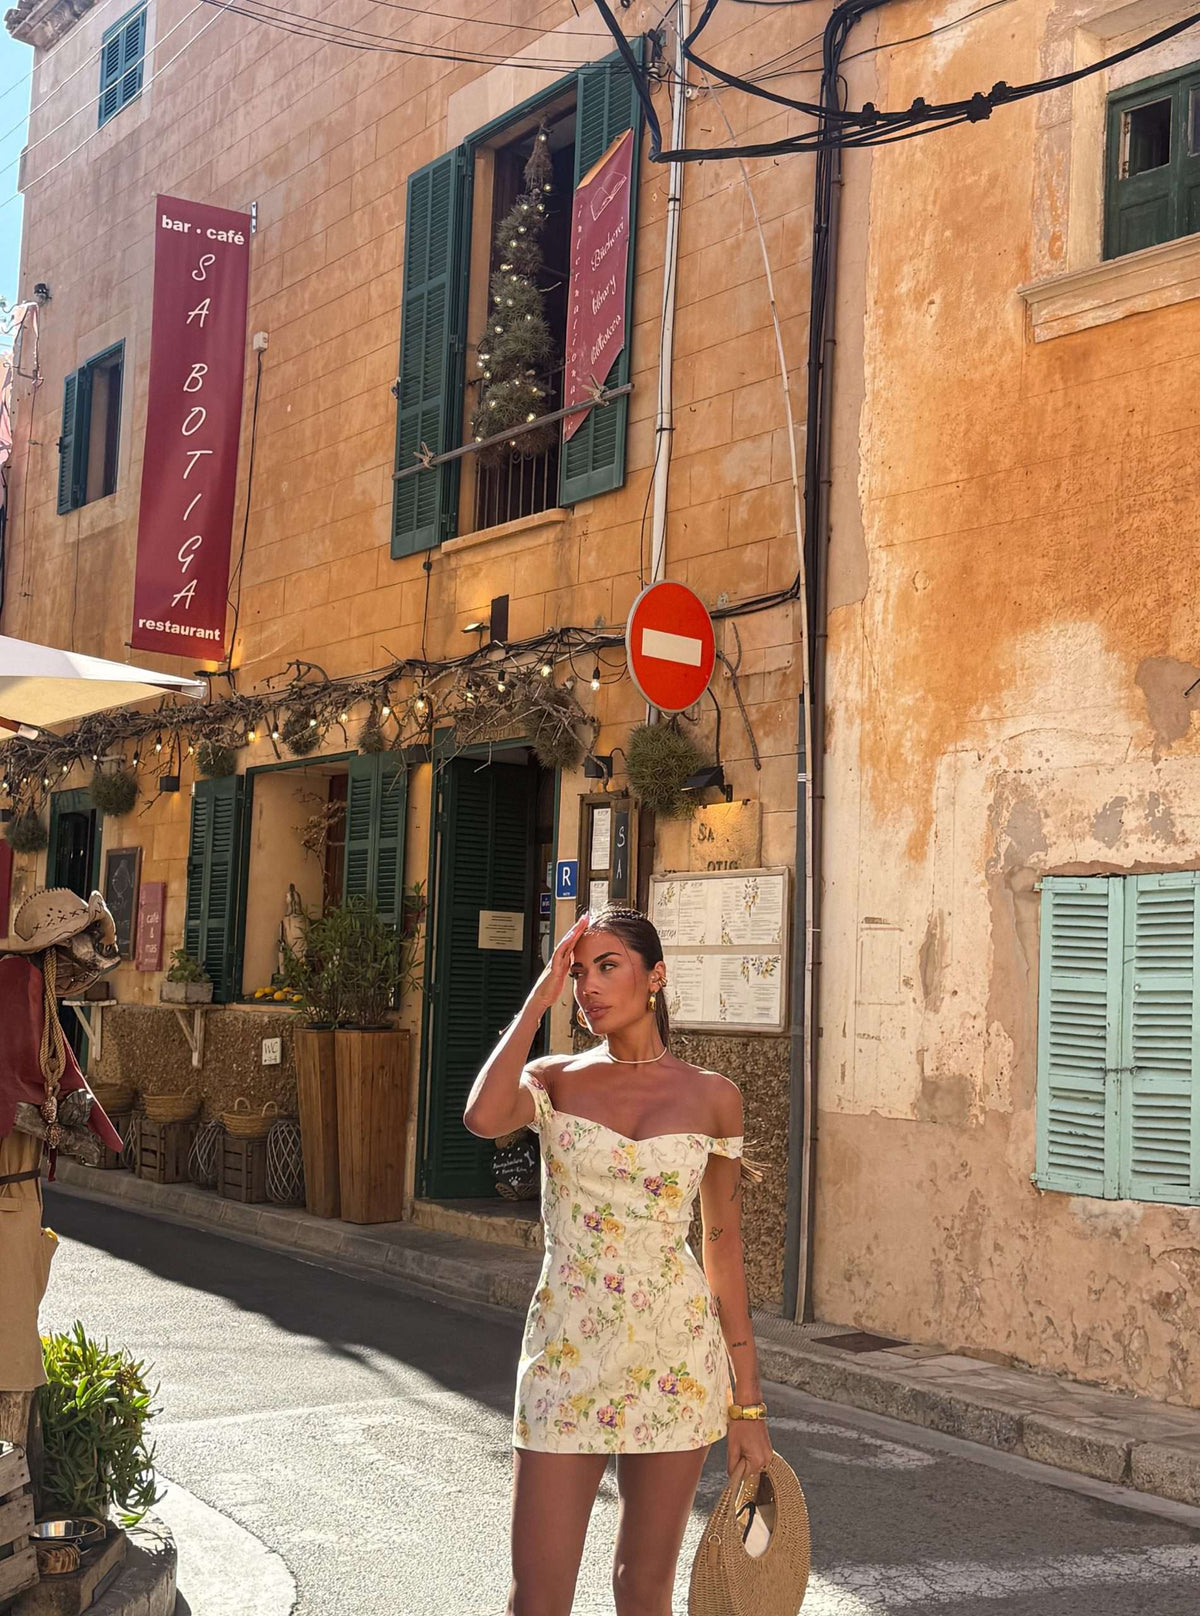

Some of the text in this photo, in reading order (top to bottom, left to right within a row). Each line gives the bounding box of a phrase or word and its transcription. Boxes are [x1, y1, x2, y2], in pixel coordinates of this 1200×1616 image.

[161, 215, 245, 245] bar café
[171, 363, 213, 609] BOTIGA
[138, 618, 221, 641] restaurant
[562, 866, 571, 886] R
